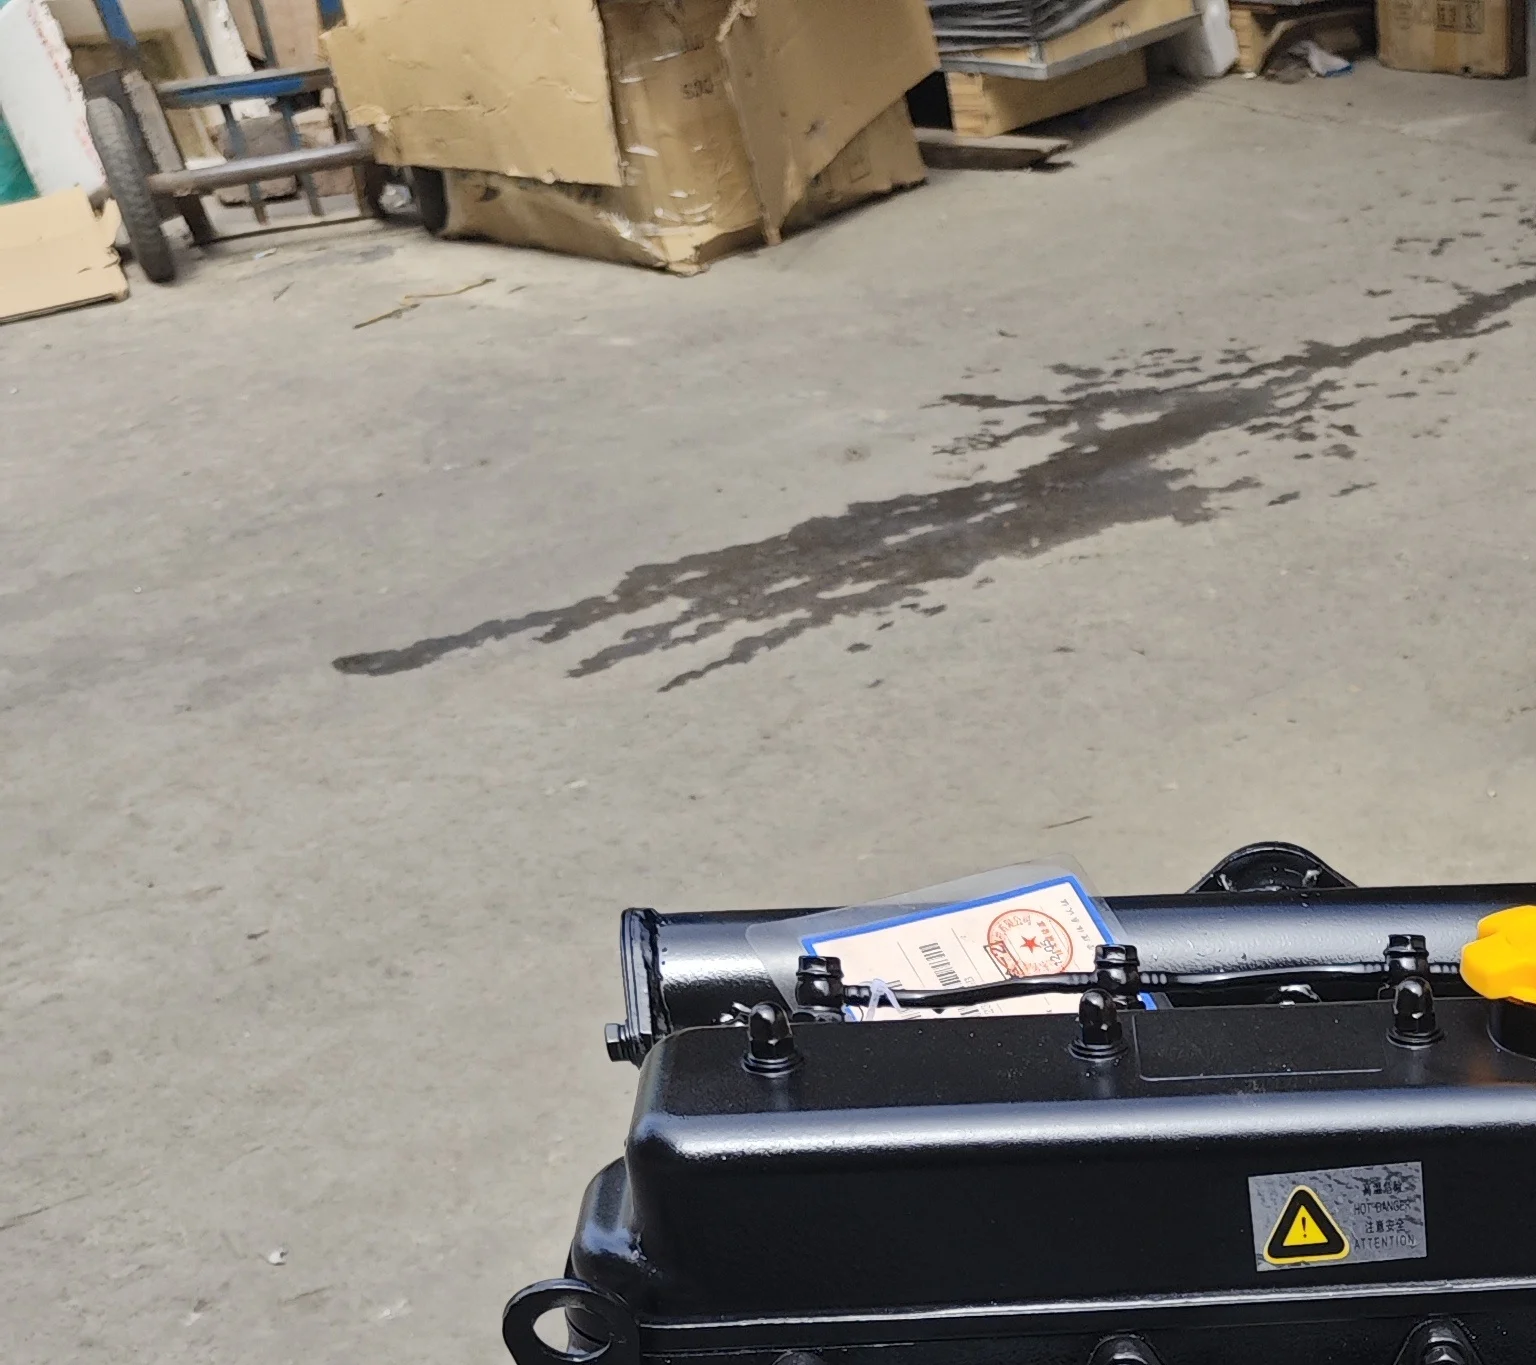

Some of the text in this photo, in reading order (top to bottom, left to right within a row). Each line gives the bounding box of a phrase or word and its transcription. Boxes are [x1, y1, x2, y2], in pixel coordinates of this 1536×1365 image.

[1364, 1218, 1406, 1234] 注意安全
[1354, 1234, 1416, 1251] ATTENTION
